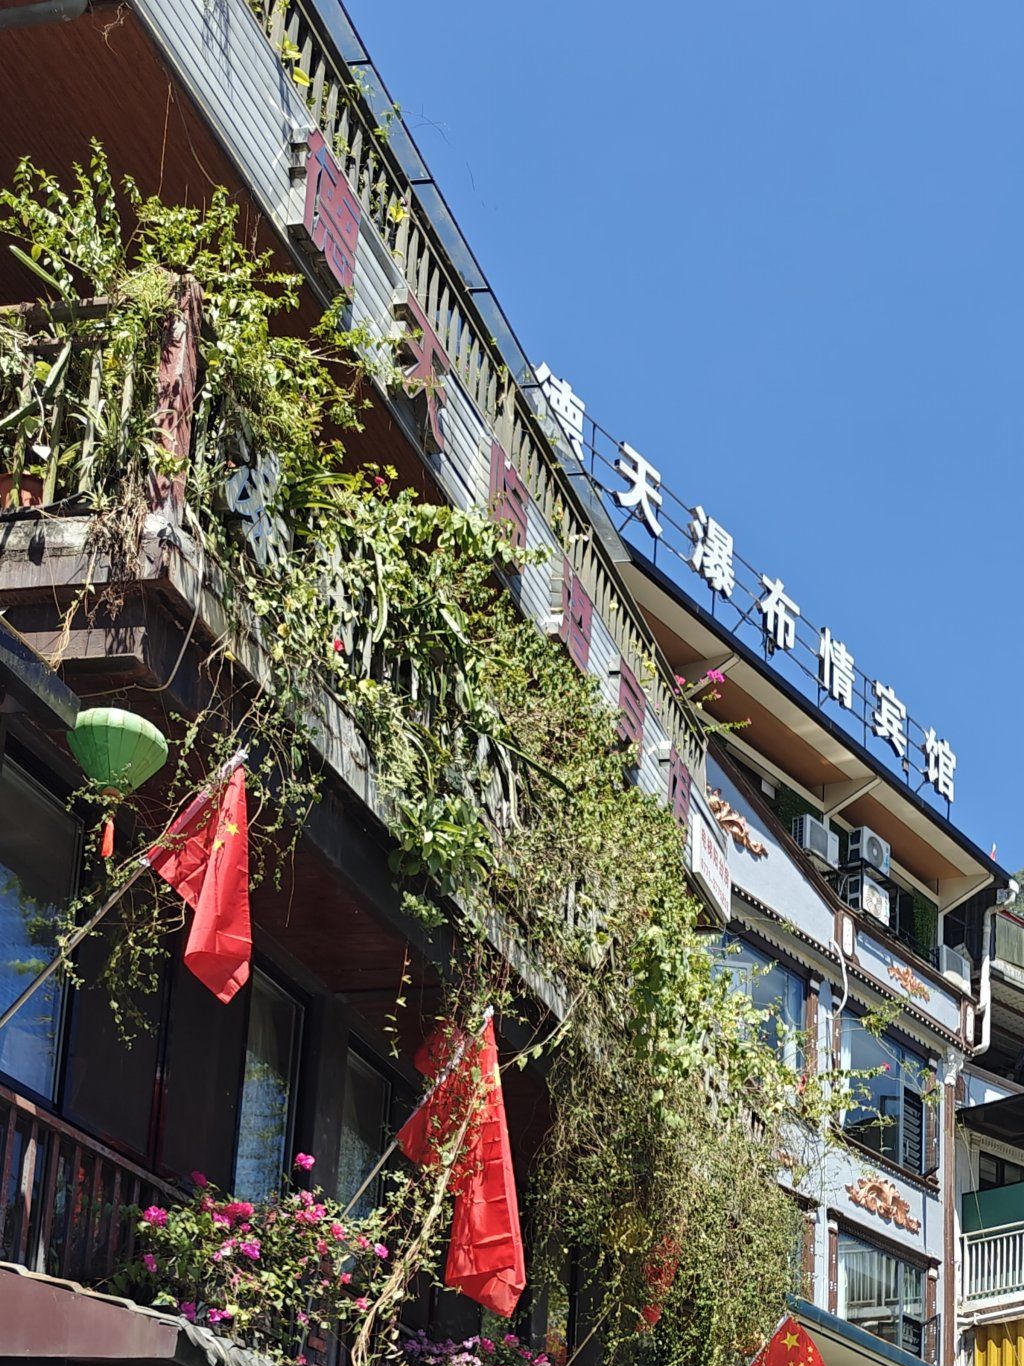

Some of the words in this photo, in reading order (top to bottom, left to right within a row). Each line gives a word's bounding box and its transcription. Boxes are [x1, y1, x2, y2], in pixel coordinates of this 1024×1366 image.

[533, 362, 956, 801] 德天瀑布情宾馆
